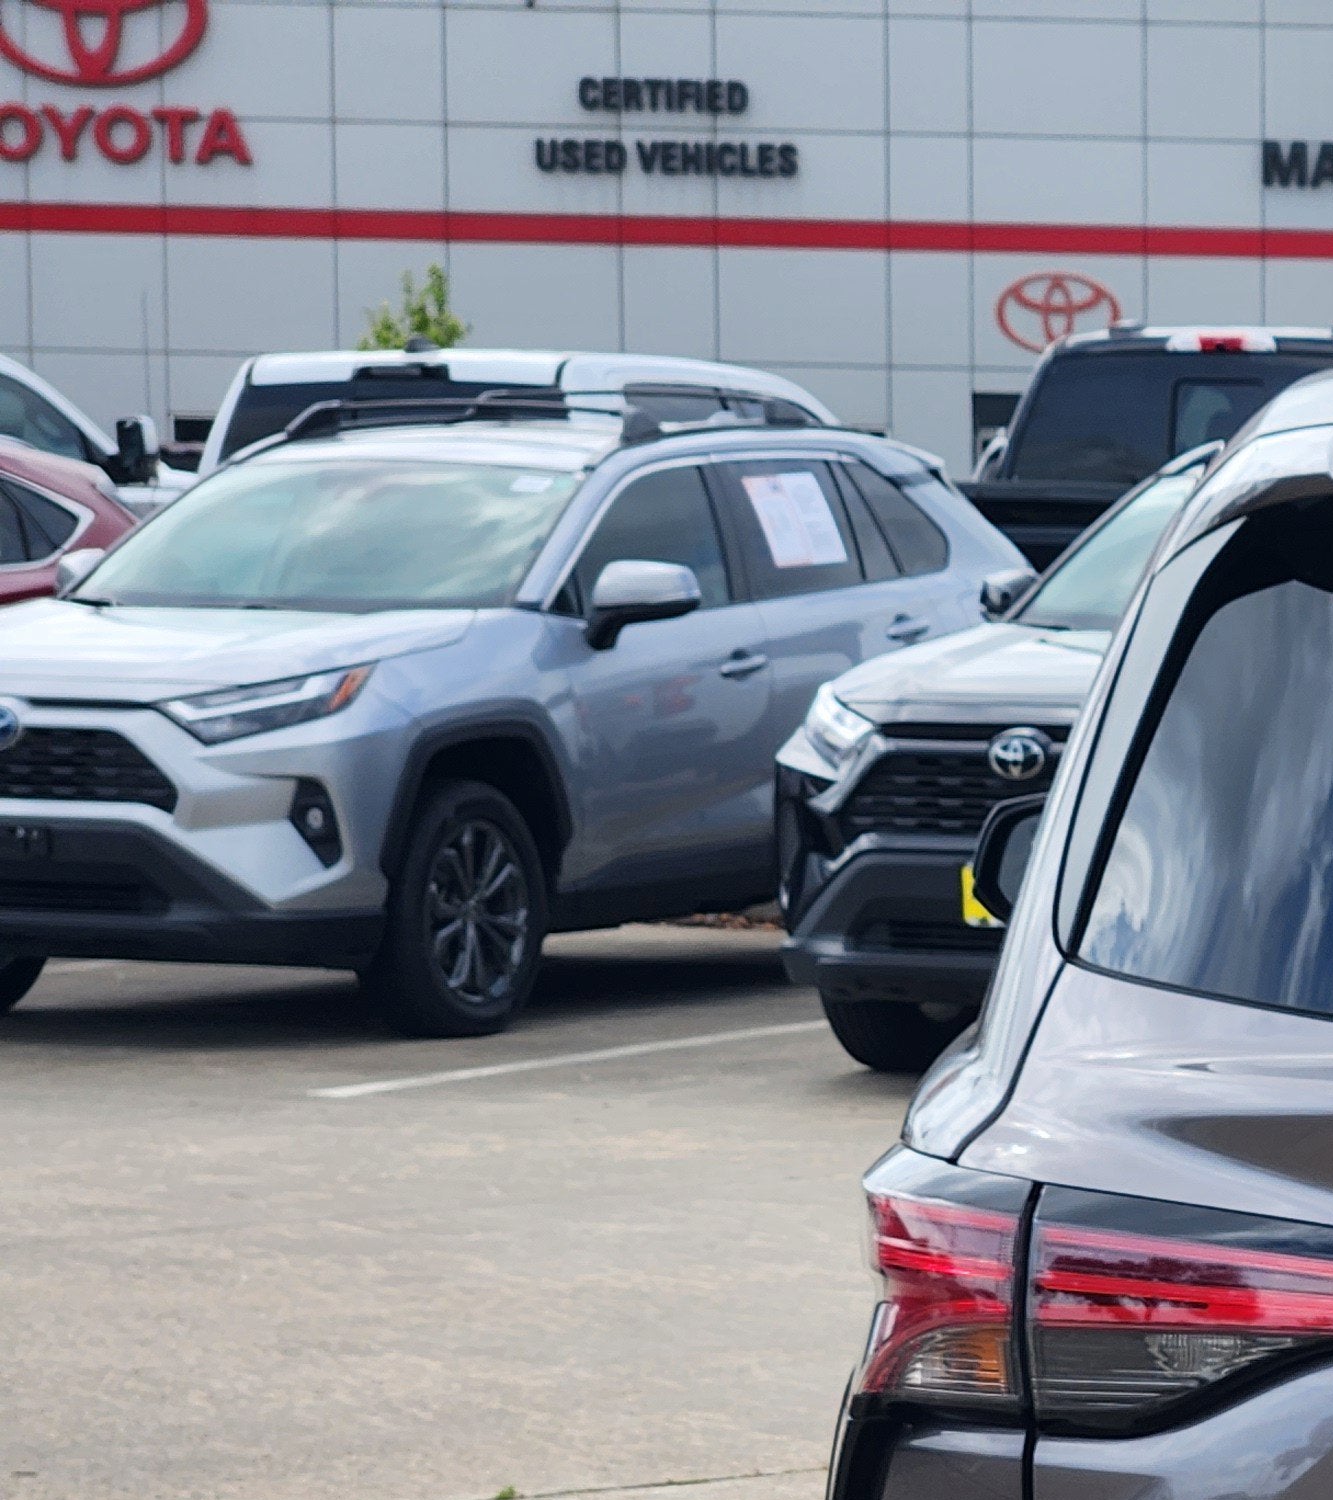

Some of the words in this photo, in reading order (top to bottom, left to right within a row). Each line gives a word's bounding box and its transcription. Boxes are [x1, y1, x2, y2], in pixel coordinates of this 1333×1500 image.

[578, 76, 749, 115] CERTIFIED
[534, 138, 628, 174] USED
[635, 139, 799, 178] VEHICLES
